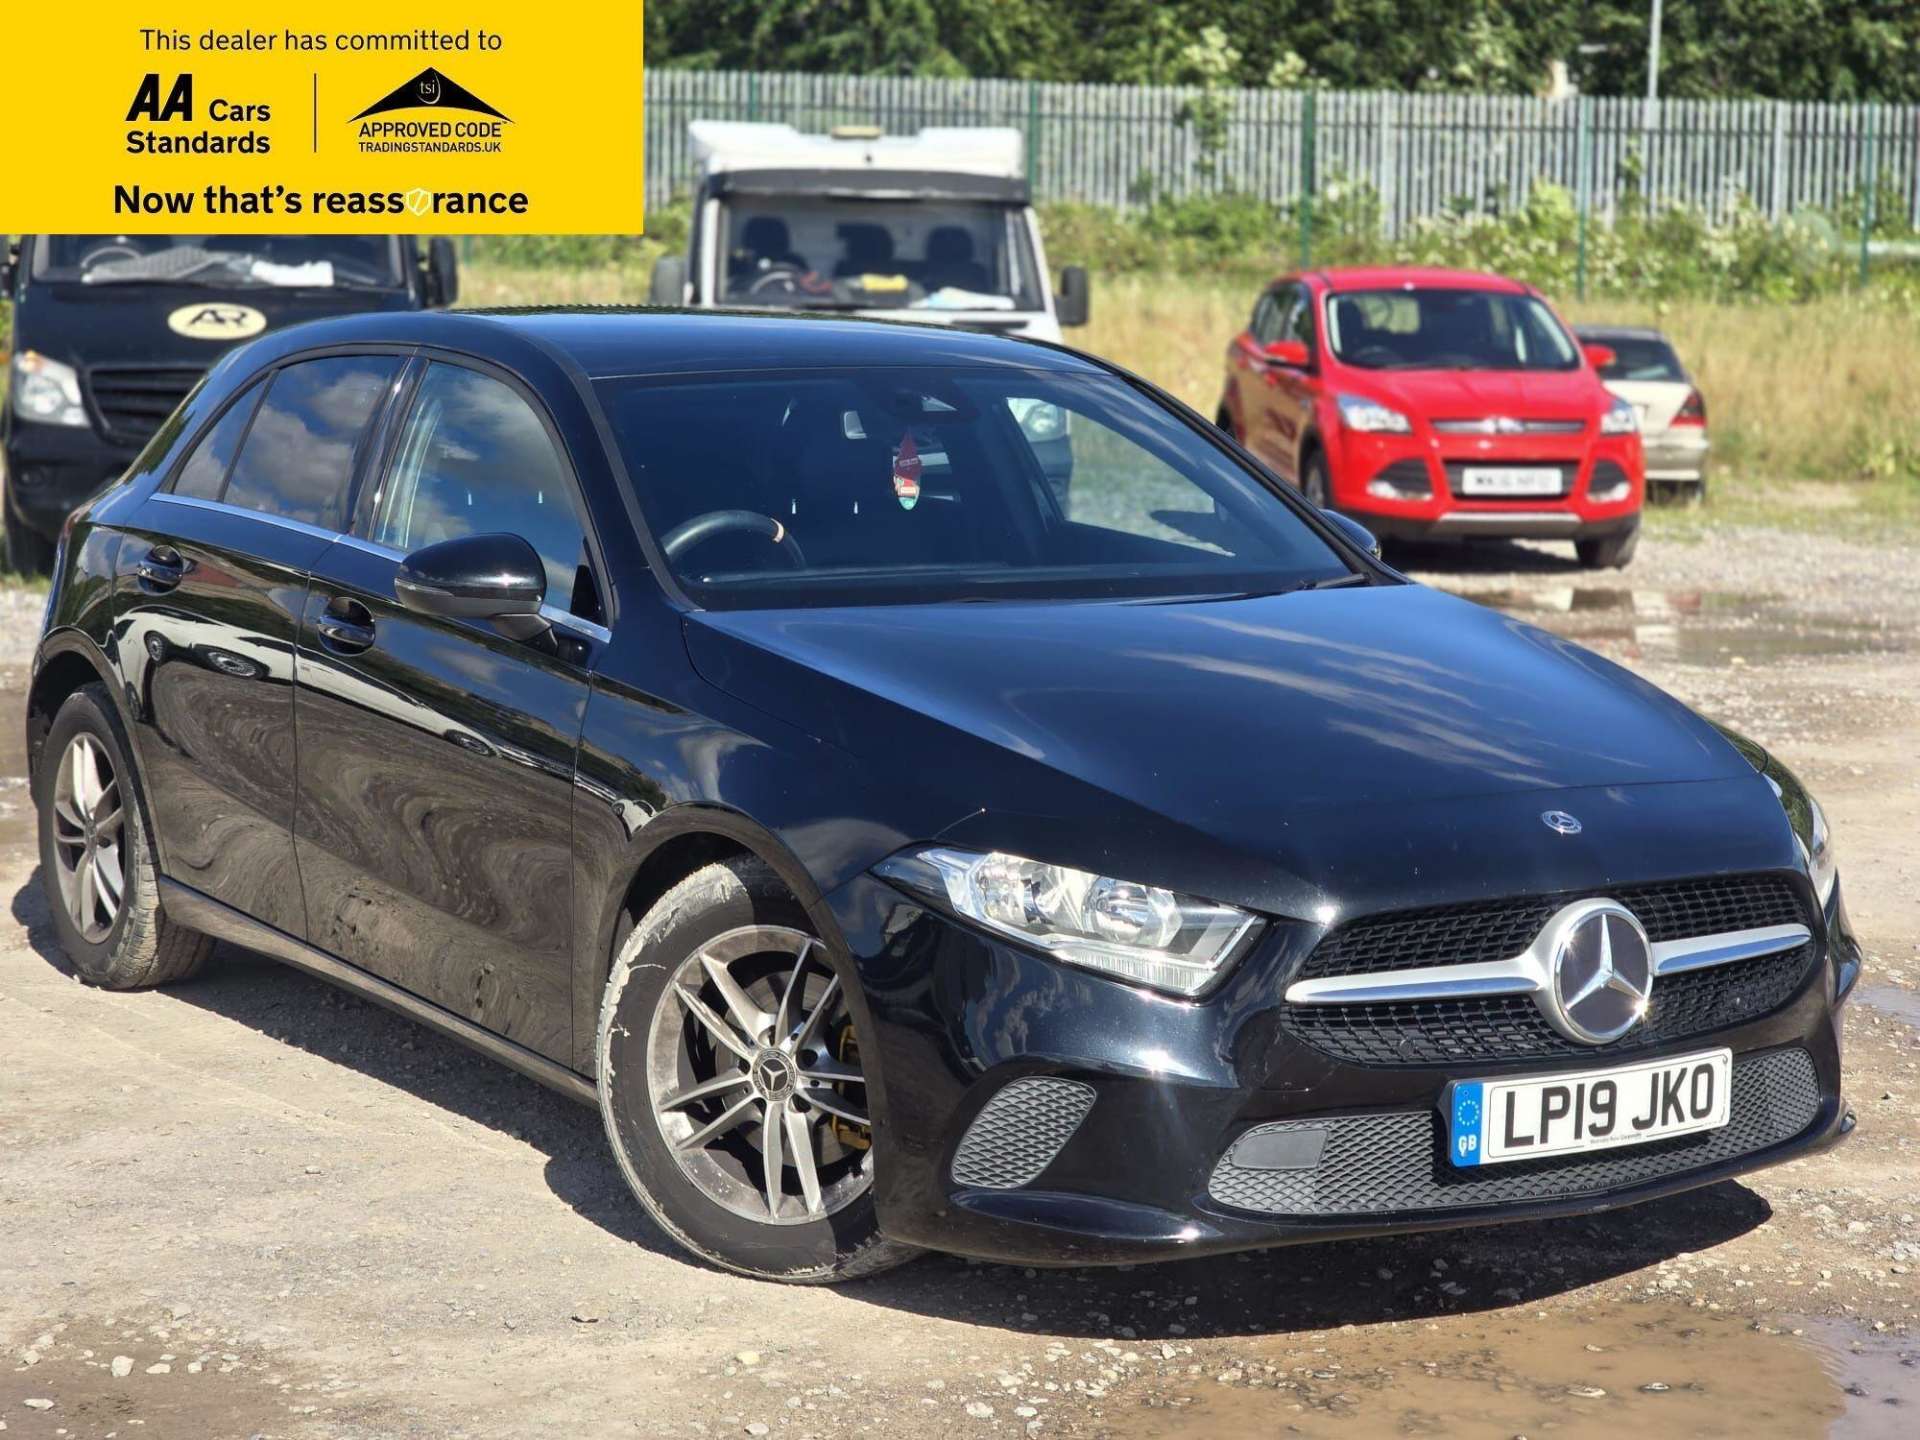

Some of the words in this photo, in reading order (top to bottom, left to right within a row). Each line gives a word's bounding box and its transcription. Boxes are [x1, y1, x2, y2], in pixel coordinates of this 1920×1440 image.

[1503, 1079, 1618, 1149] LP19
[1631, 1062, 1715, 1131] JKO
[1458, 1134, 1477, 1152] GB
